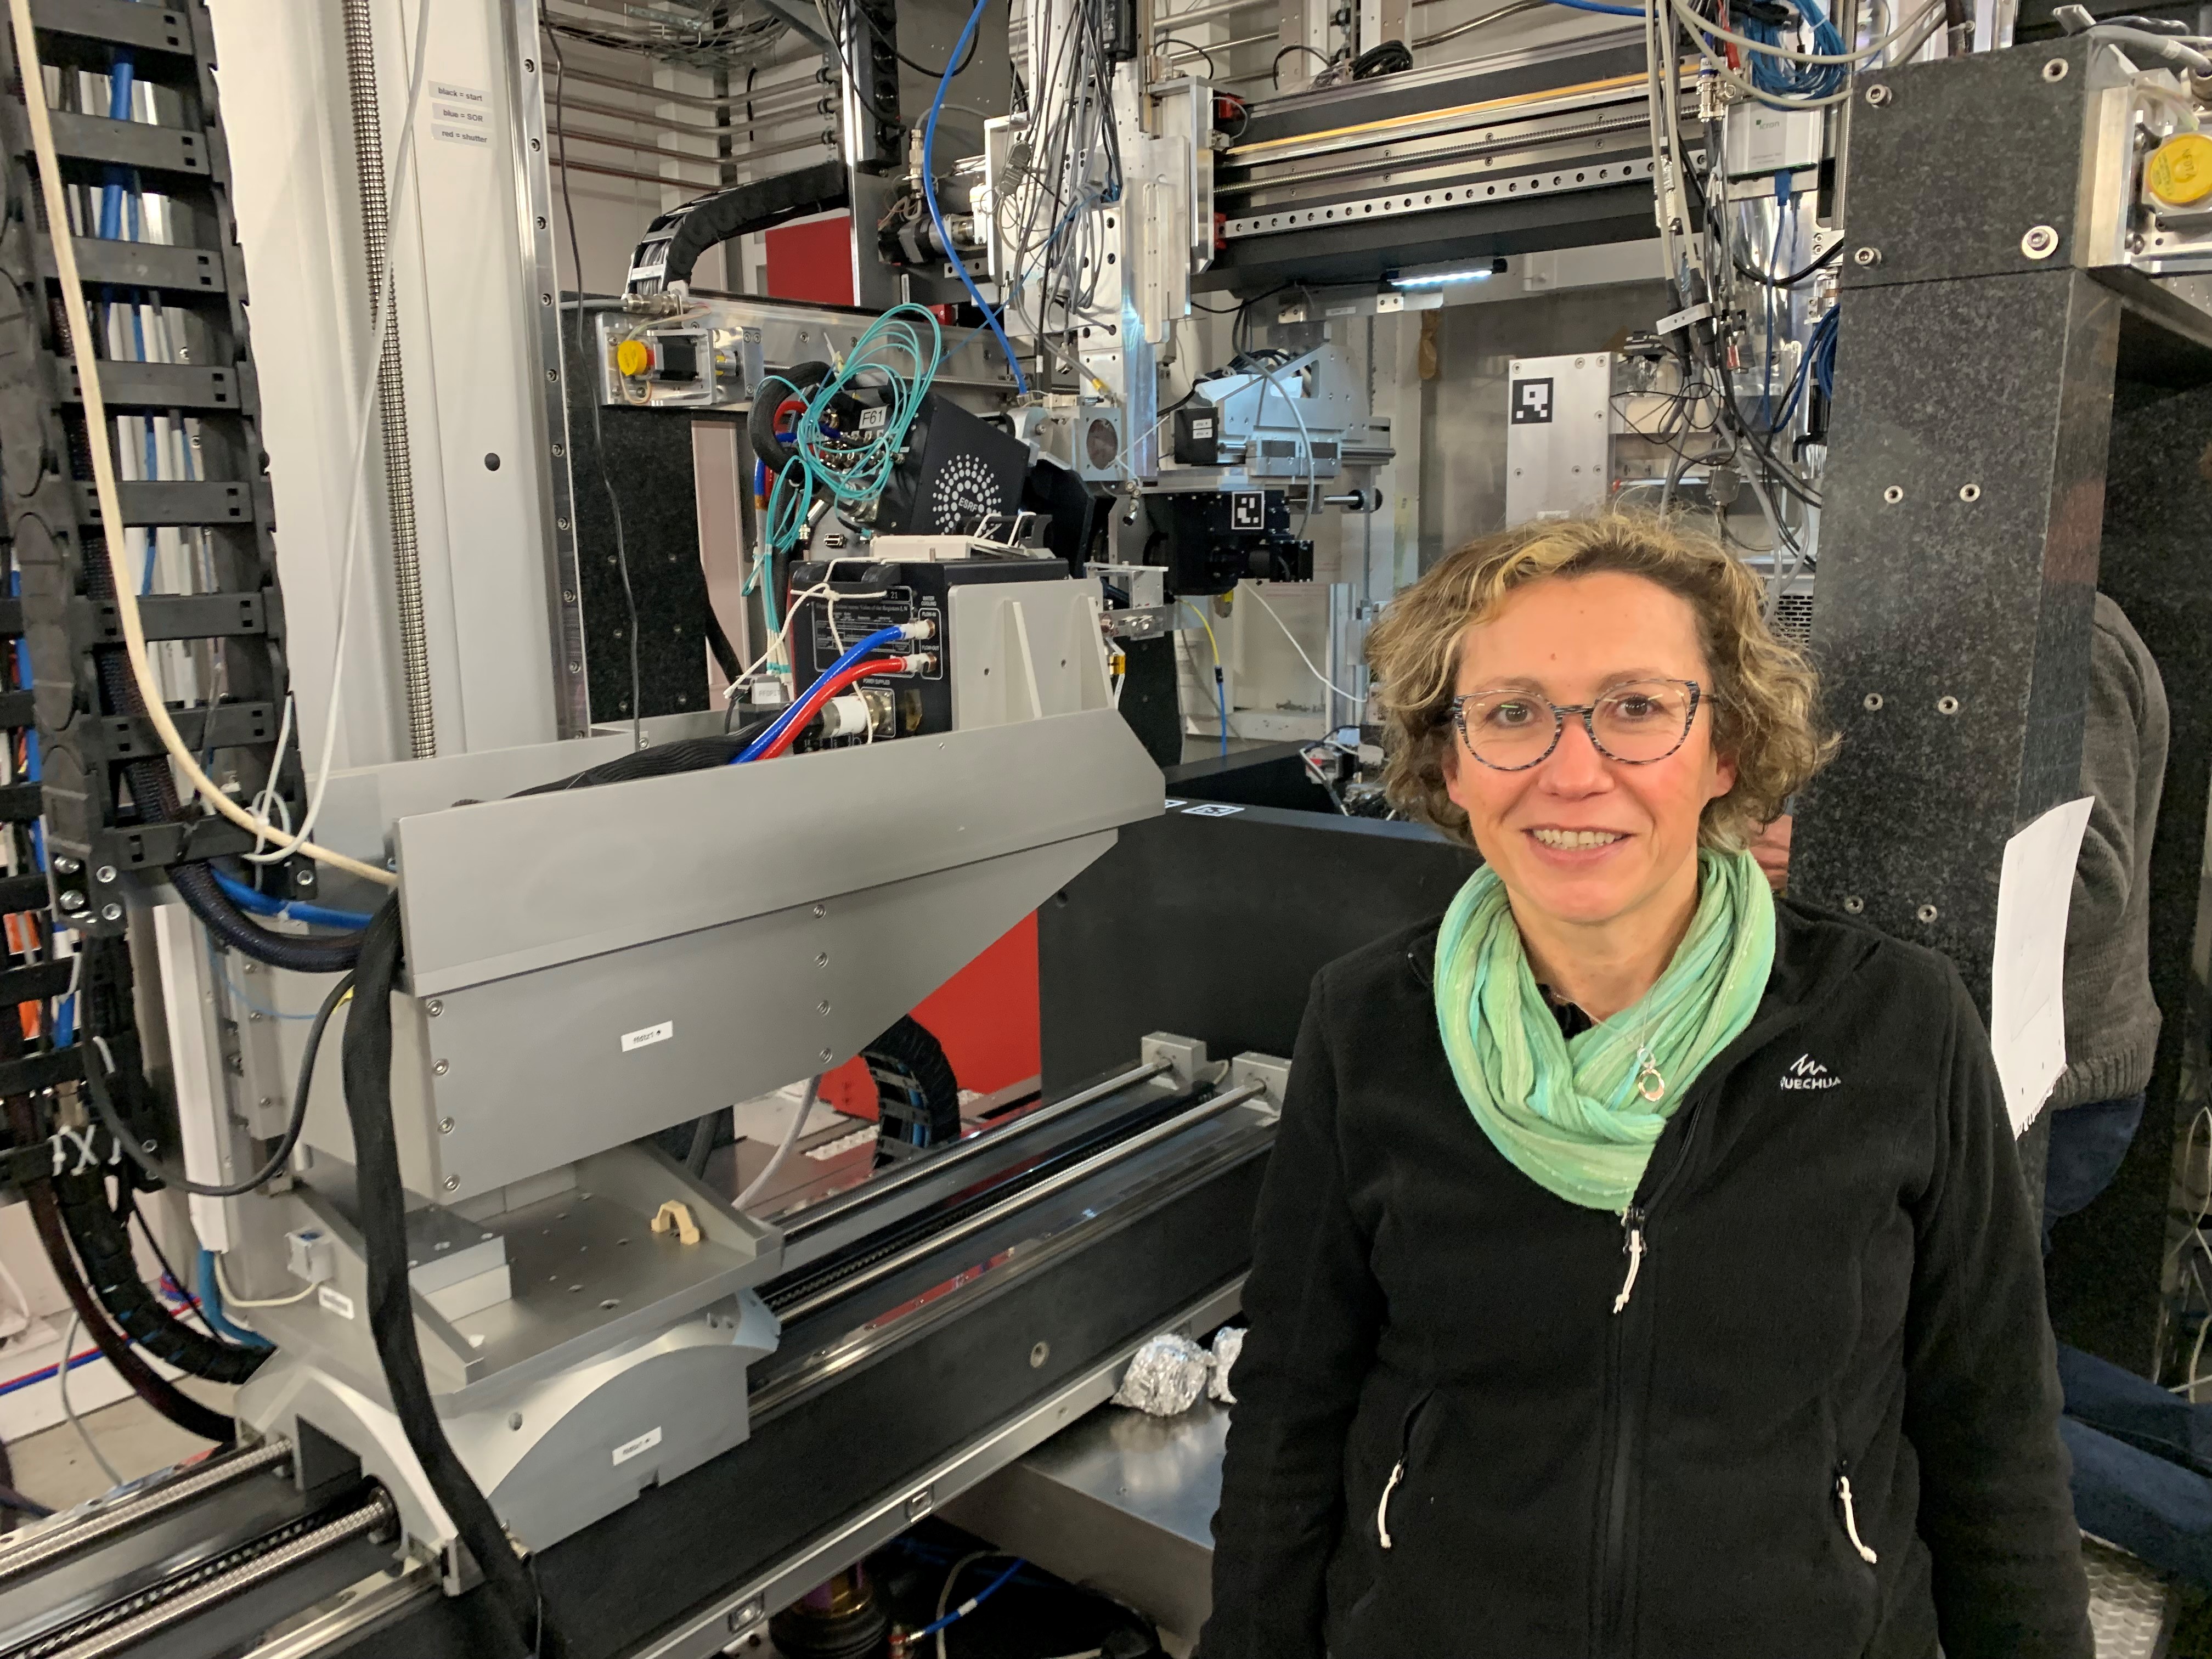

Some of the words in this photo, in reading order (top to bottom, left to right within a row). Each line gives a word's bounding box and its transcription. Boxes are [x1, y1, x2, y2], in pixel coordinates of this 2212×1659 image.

[438, 87, 458, 97] black
[466, 93, 483, 101] start
[443, 109, 459, 118] blue
[467, 113, 483, 122] SOR
[462, 133, 487, 143] shutter
[862, 409, 883, 426] F61
[958, 496, 978, 512] ESRF
[890, 591, 898, 600] 21
